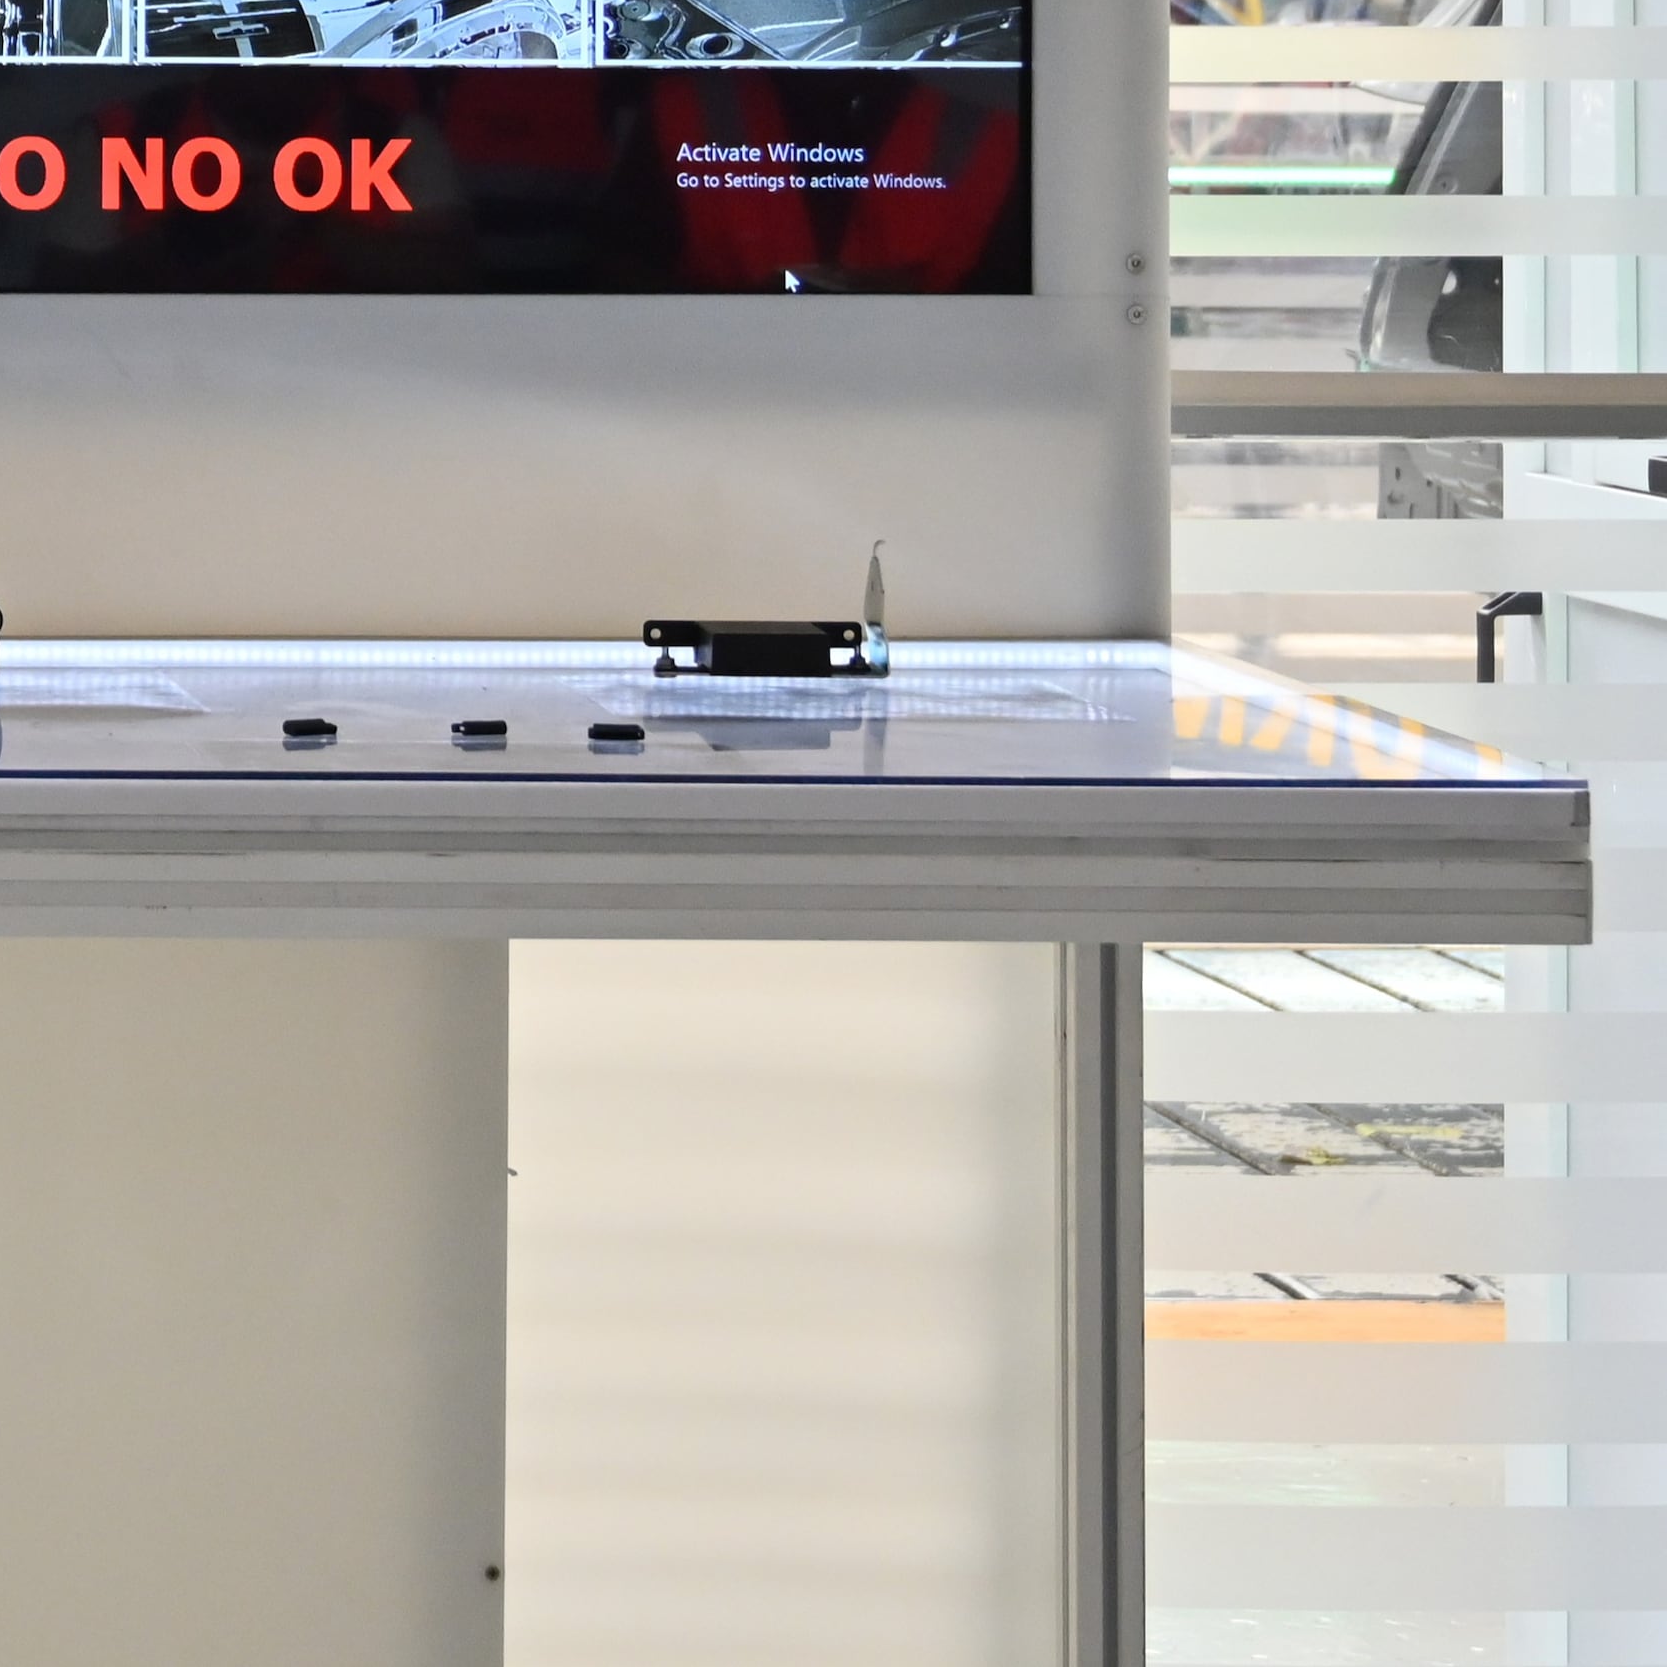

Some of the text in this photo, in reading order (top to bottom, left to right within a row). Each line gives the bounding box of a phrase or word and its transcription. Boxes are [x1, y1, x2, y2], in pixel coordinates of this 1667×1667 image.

[676, 142, 865, 163] Activate Windows
[101, 136, 242, 213] NO
[273, 137, 413, 213] OK
[676, 172, 948, 193] Go to Settings to activate Windows.
